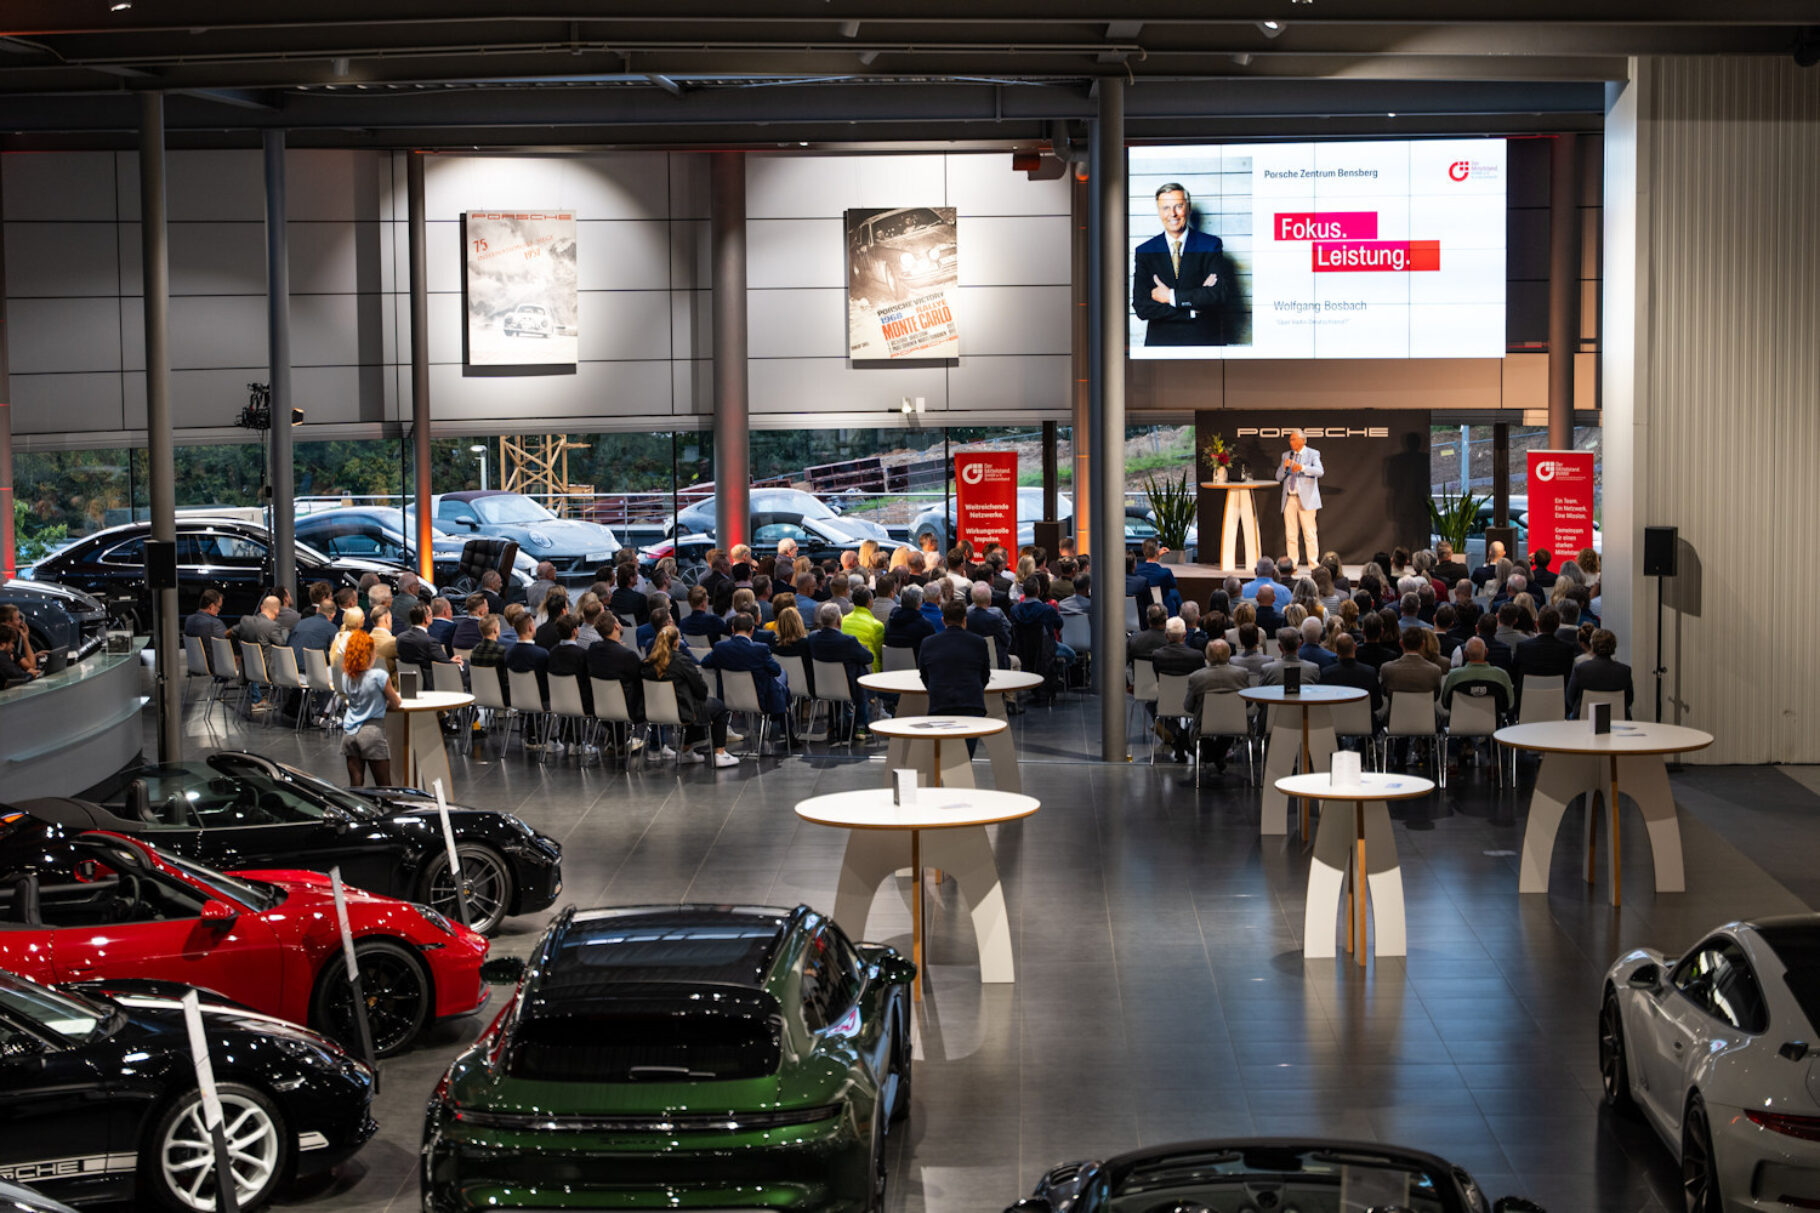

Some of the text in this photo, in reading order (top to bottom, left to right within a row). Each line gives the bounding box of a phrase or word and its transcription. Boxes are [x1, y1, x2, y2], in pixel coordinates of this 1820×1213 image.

[1264, 168, 1378, 179] Porsche Zentrum Bensberg
[1281, 217, 1347, 239] Fokus.
[1317, 245, 1410, 271] Leistung.
[877, 300, 912, 316] PORSCHE
[1274, 300, 1367, 313] Wolfgang Bosbach
[882, 316, 919, 341] MONTE
[918, 306, 952, 330] CARLO
